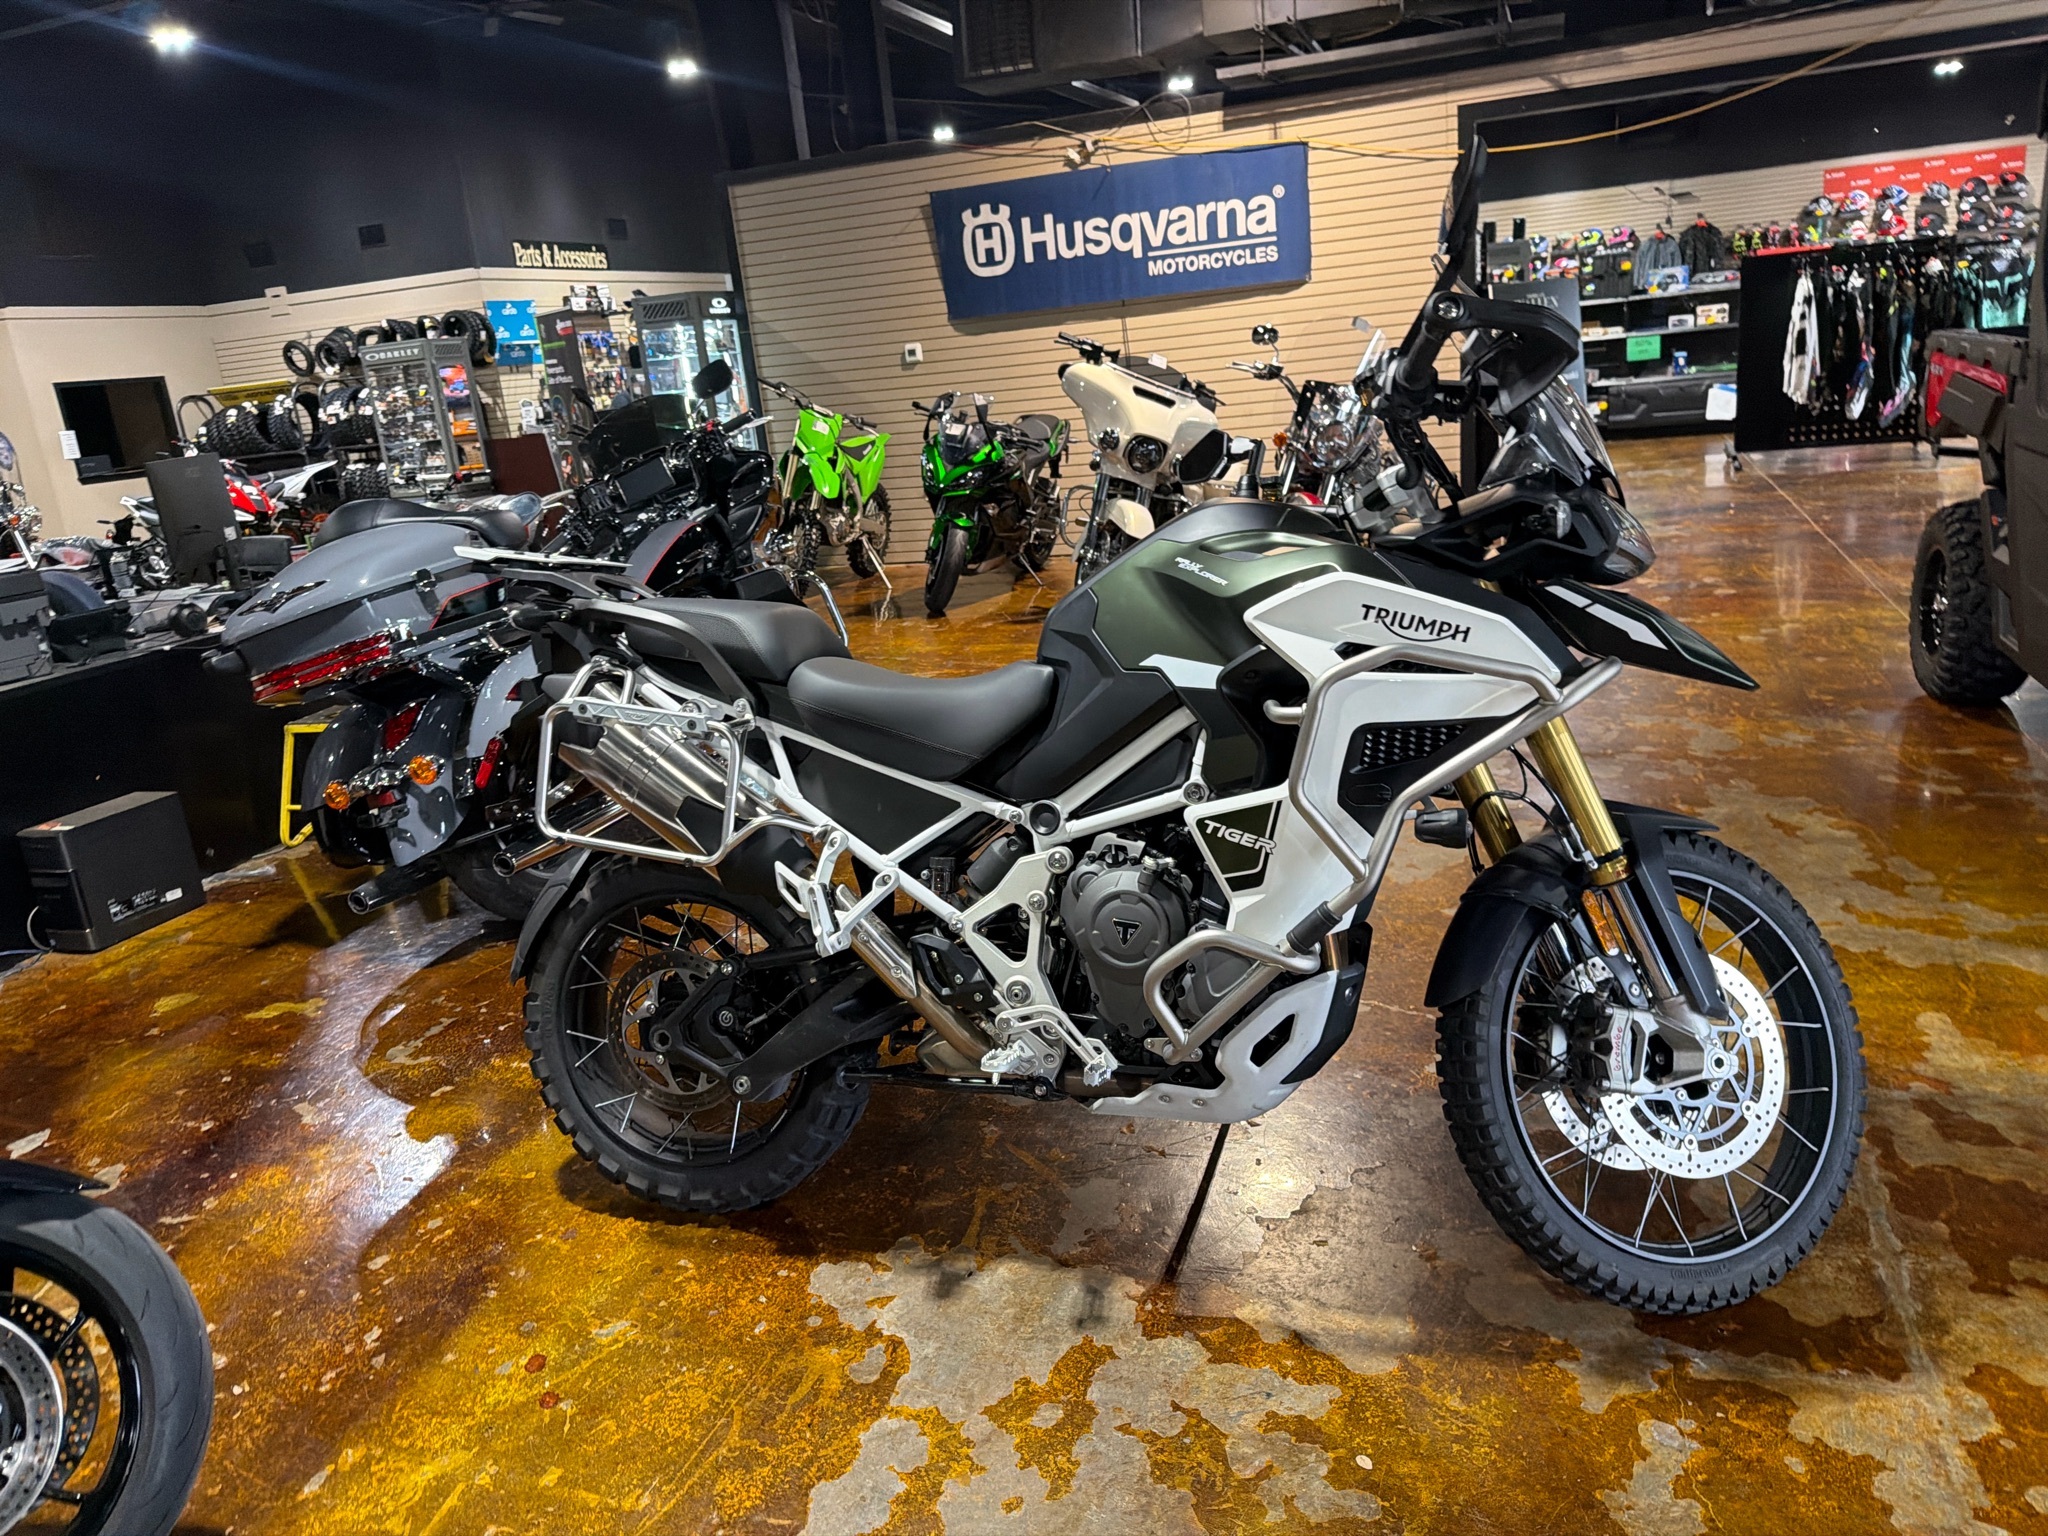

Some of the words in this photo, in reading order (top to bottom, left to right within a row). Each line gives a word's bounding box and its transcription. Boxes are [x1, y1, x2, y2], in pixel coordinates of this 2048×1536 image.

[1021, 194, 1278, 263] Husqvarna
[512, 241, 543, 267] Parts
[541, 243, 554, 268] &
[553, 244, 608, 270] Accessories
[1148, 245, 1278, 276] MOTORCYCLES
[379, 348, 420, 360] OAKLEY
[1361, 603, 1471, 643] TRIUMPH
[1203, 819, 1277, 855] TIGER
